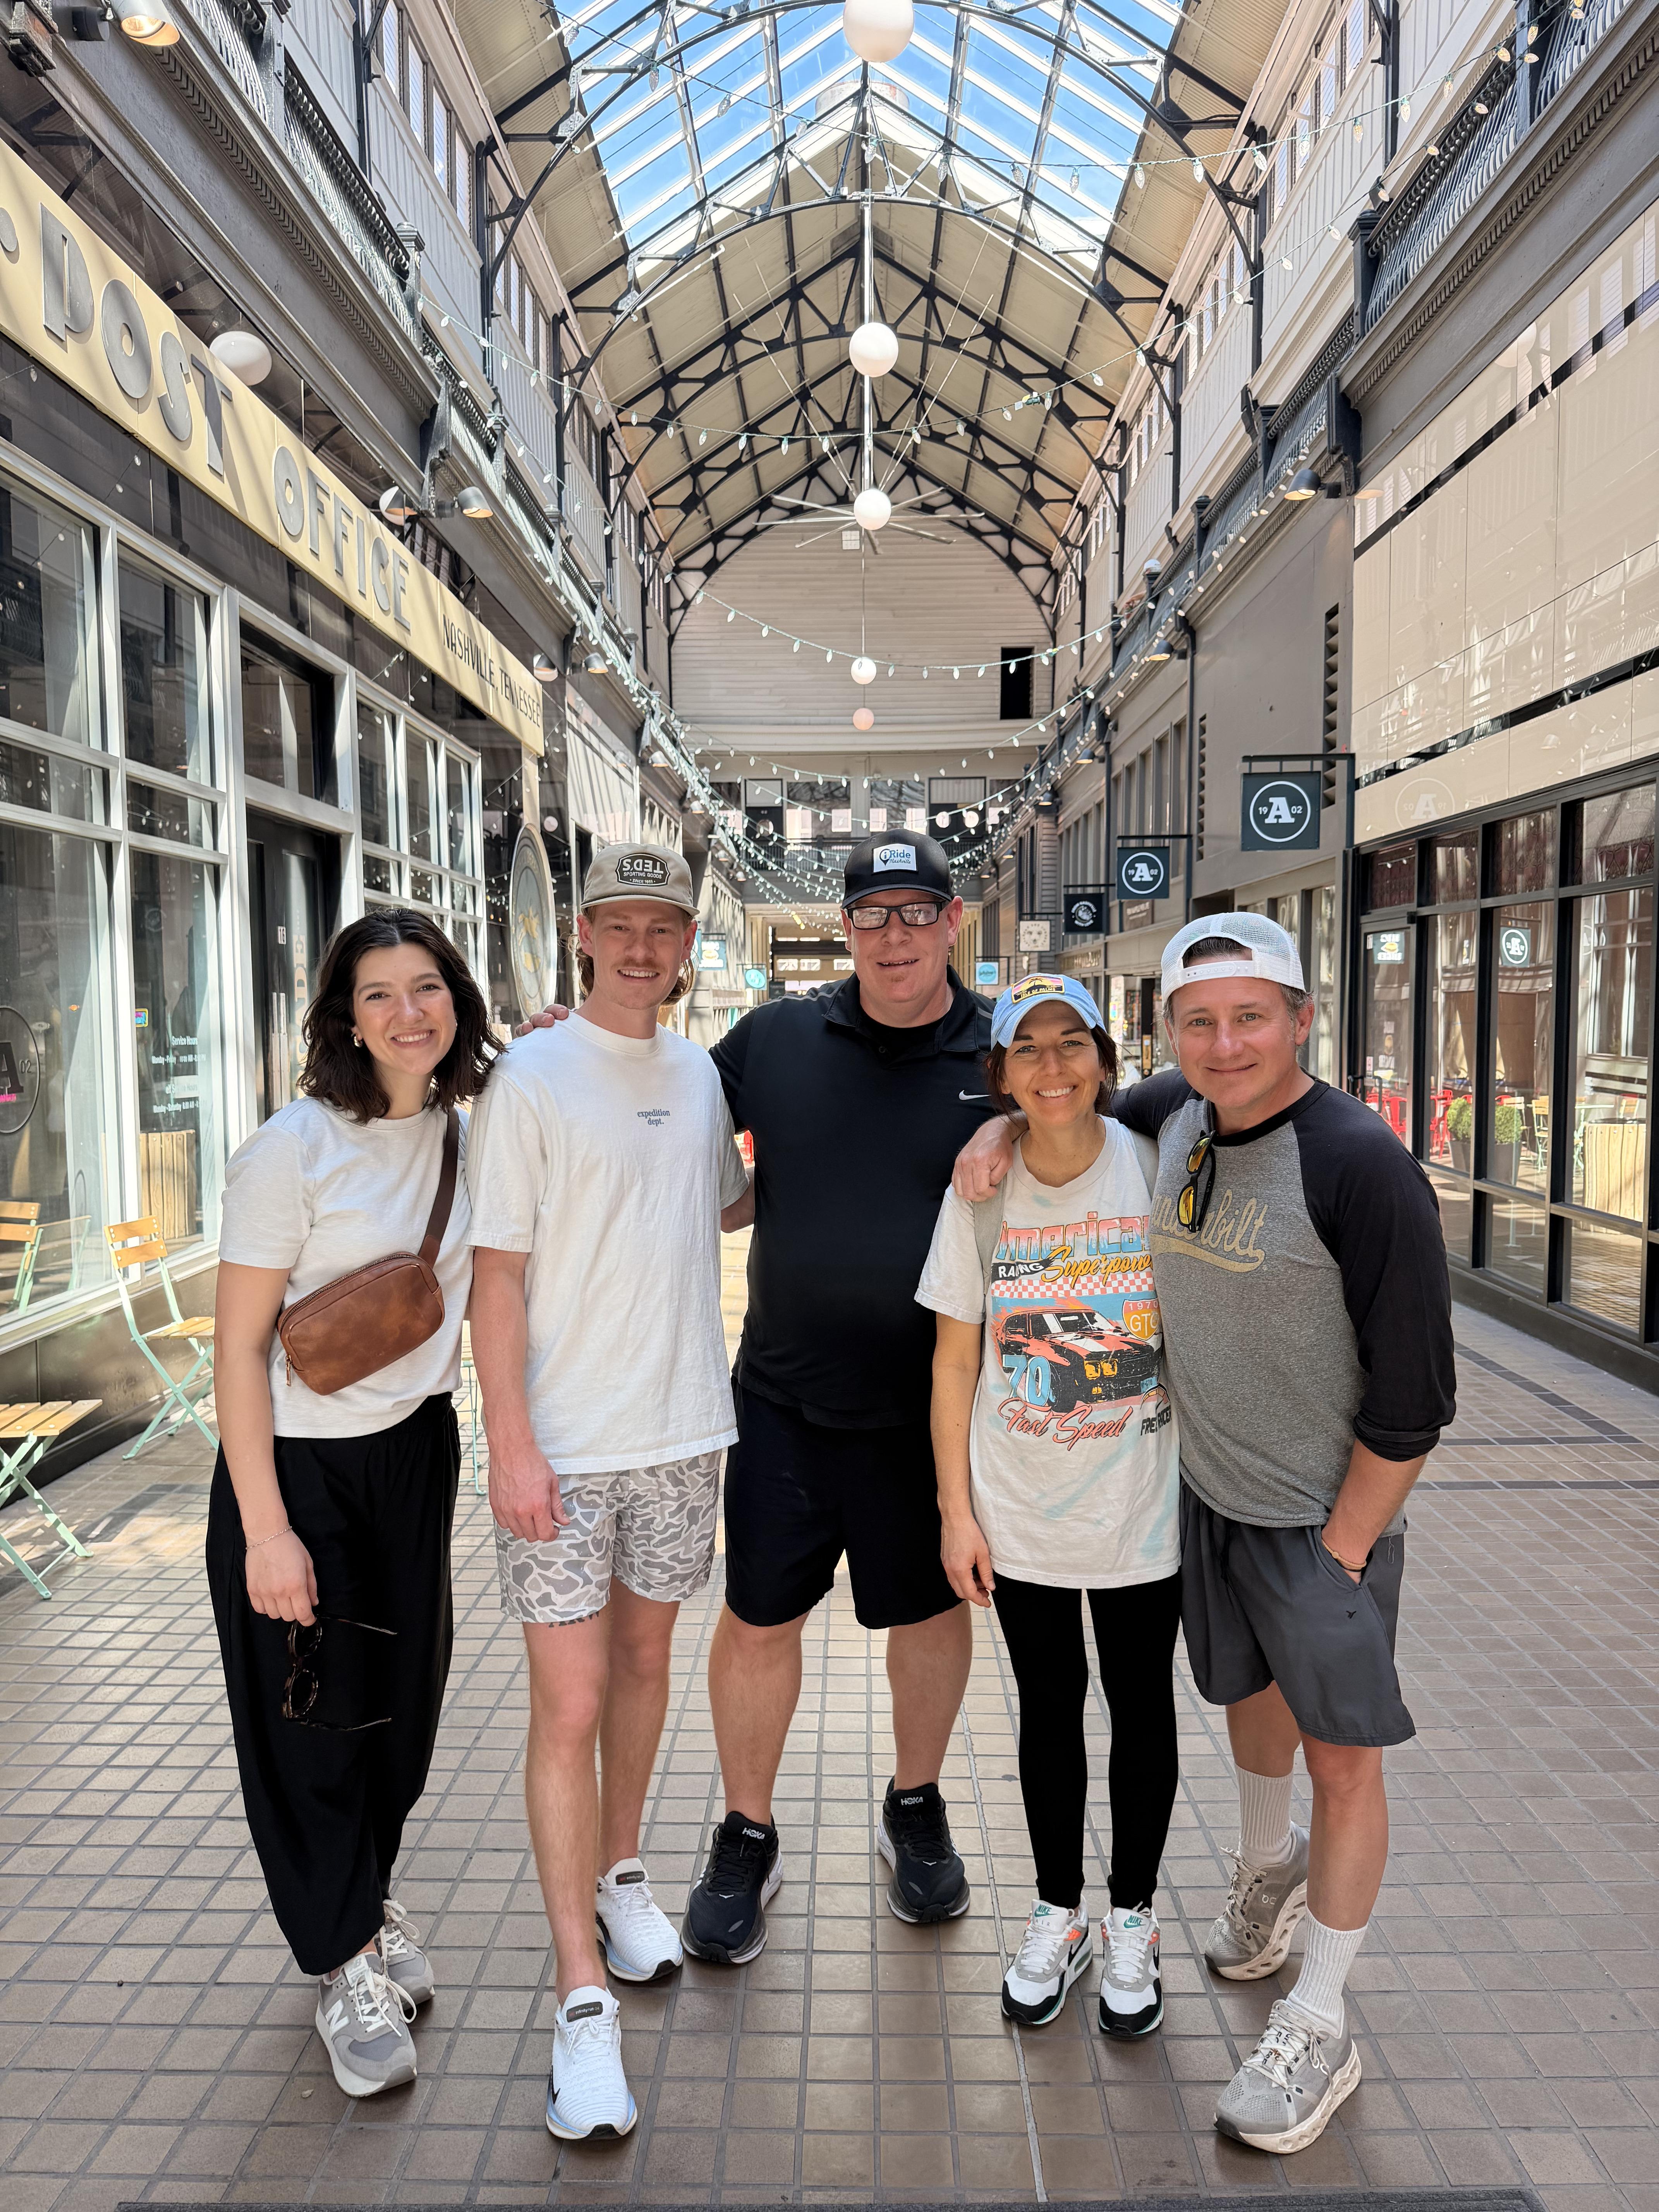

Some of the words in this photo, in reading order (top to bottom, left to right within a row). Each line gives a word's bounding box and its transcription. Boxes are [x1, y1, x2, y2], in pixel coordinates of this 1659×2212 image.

[40, 202, 232, 477] POST
[274, 446, 410, 631] OFFICE
[443, 613, 498, 692] NASHVILLE,
[499, 666, 540, 728] TENNESSEE
[1259, 806, 1268, 815] 19
[1264, 797, 1295, 824] A
[1291, 805, 1303, 814] 02
[1132, 863, 1153, 881] A
[279, 928, 285, 942] 16
[20, 1059, 31, 1073] 02
[637, 1109, 670, 1119] expedition
[647, 1118, 664, 1127] dept.
[1128, 1300, 1160, 1311] 1970
[1130, 1312, 1159, 1336] GTO
[1002, 1354, 1052, 1407] 70
[997, 1396, 1053, 1437] Fast
[1052, 1405, 1134, 1451] Speed
[901, 1796, 923, 1806] HOKA
[742, 1827, 765, 1839] HOKA
[1037, 1904, 1053, 1914] NIKE
[1036, 1918, 1050, 1927] AIR
[1127, 1915, 1143, 1925] NIKE
